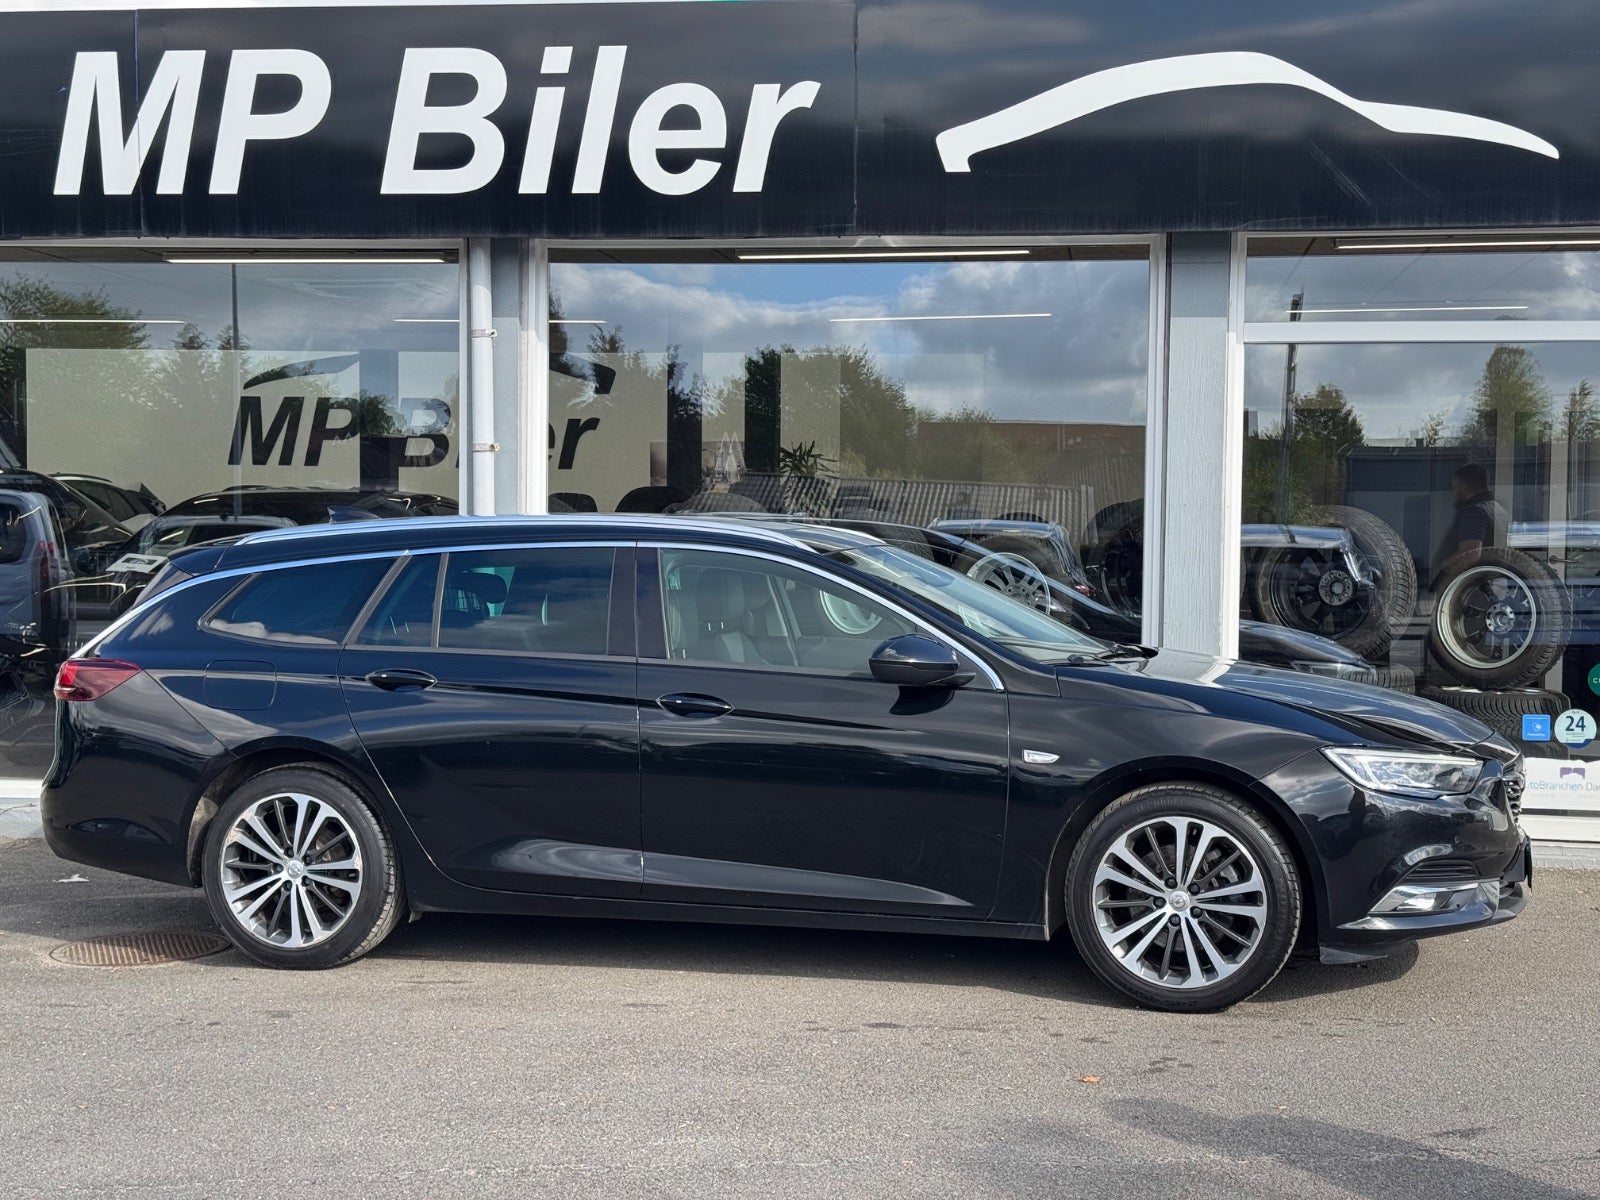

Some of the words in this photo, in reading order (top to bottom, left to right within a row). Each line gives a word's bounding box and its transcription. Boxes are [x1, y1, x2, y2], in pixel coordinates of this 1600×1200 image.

[54, 48, 331, 195] MP
[380, 45, 821, 195] Biler
[228, 396, 359, 466] MP
[1565, 715, 1586, 732] 24
